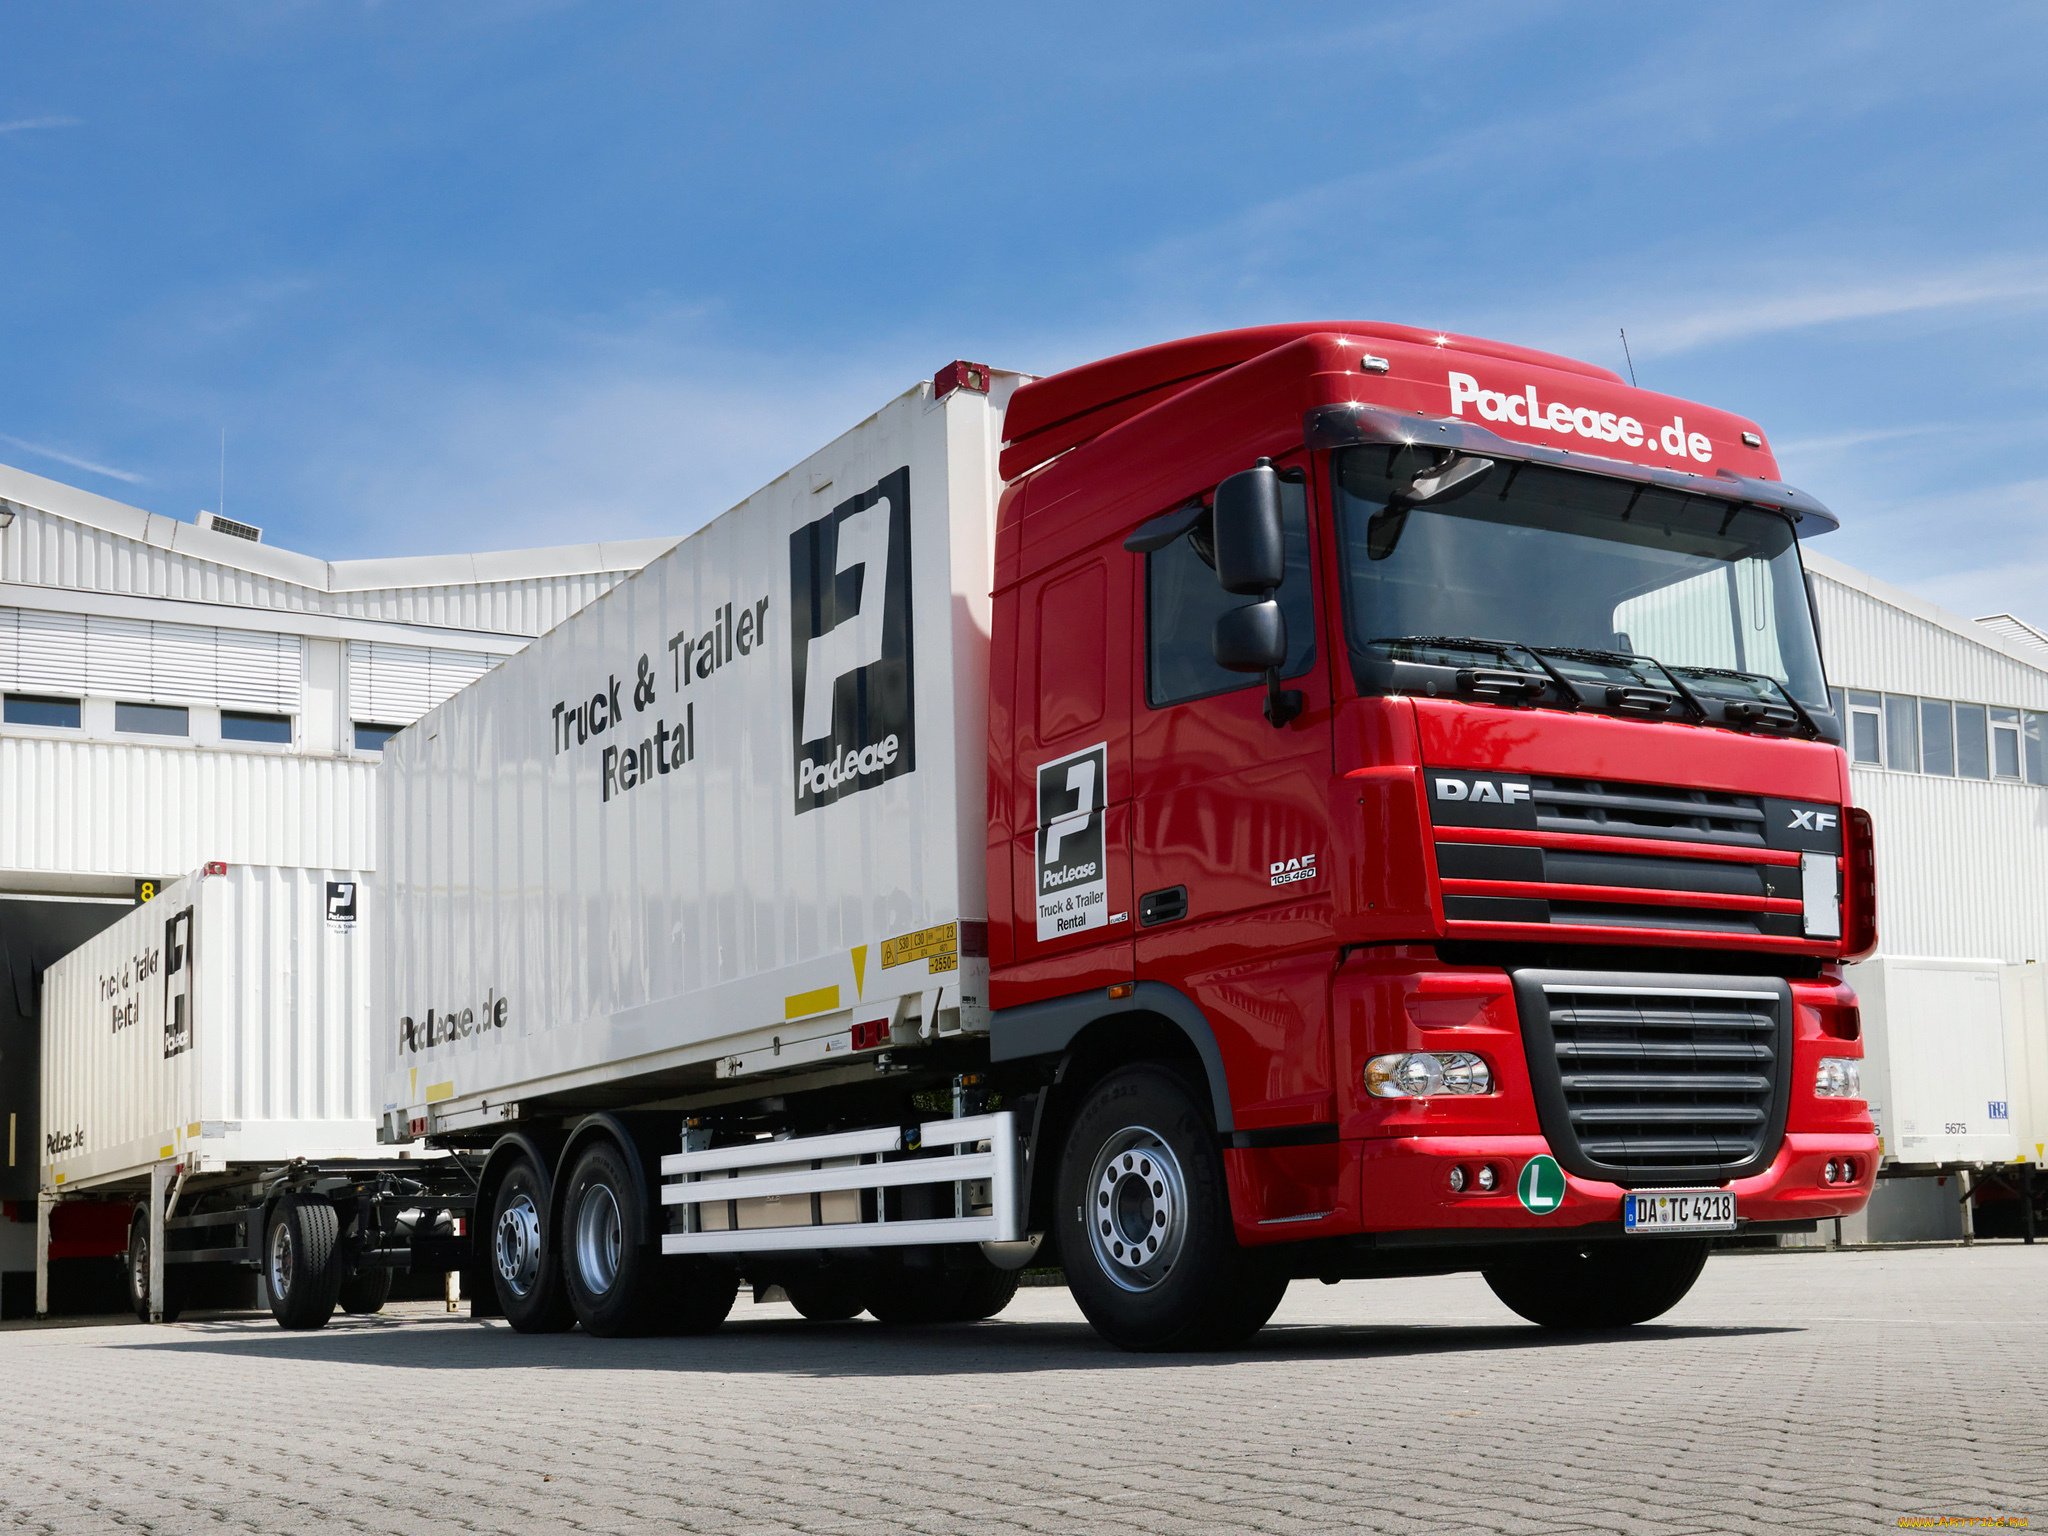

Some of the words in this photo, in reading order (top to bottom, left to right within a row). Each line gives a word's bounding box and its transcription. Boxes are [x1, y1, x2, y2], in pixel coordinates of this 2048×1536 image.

[1448, 371, 1712, 462] PacLease.de
[552, 674, 622, 755] Truck
[634, 653, 655, 712] &
[668, 594, 769, 693] Trailer
[603, 702, 694, 802] Rental
[1435, 778, 1530, 804] DAF
[1787, 809, 1837, 831] XF
[1043, 861, 1096, 889] PacLease
[1270, 854, 1316, 875] DAF
[1272, 868, 1315, 885] 105.460
[141, 882, 154, 902] 8
[1039, 899, 1064, 918] Truck
[1065, 896, 1073, 911] &
[1076, 890, 1104, 908] Trailer
[1057, 912, 1086, 931] Rental
[914, 933, 924, 946] C30
[947, 925, 954, 938] 23
[935, 956, 951, 971] 2550
[1945, 1123, 1967, 1134] 5675
[1529, 1164, 1554, 1206] L
[1637, 1198, 1657, 1222] DA
[1669, 1198, 1688, 1221] TC
[1693, 1196, 1731, 1220] 4218
